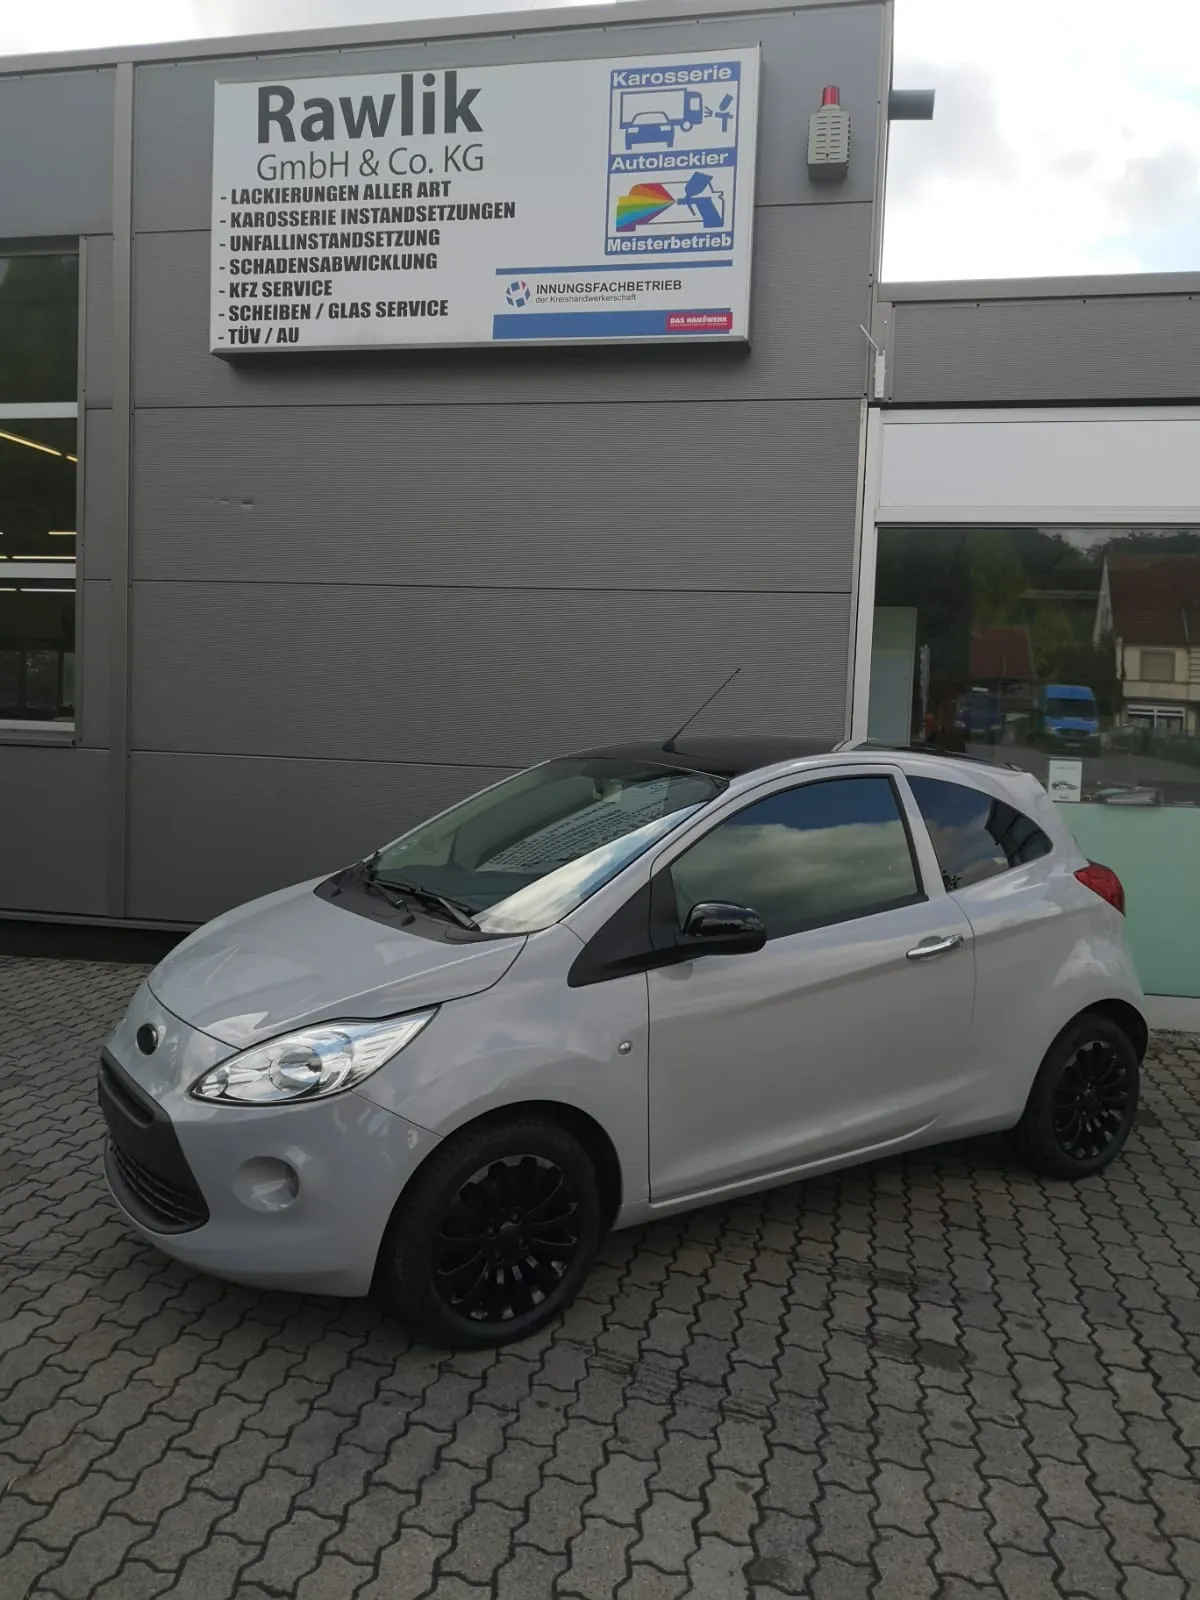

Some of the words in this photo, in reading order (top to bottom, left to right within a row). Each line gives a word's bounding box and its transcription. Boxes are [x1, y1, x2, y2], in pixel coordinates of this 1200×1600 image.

[612, 65, 732, 87] Karosserie
[257, 70, 484, 144] Rawlik
[257, 150, 350, 181] GmbH
[359, 148, 380, 177] &
[388, 147, 433, 175] Co.
[444, 144, 484, 172] KG
[611, 151, 728, 170] Autolackier
[231, 184, 359, 205] LACKIERUNGEN
[363, 182, 412, 200] ALLER
[417, 180, 451, 198] ART
[230, 209, 336, 228] KAROSSERIE
[341, 202, 516, 225] INSTANDSETZUNGEN
[230, 229, 440, 252] UNFALLINSTANDSETZUNG
[607, 233, 732, 252] Meisterbetrieb
[229, 253, 438, 275] SCHADENSABWICKLUNG
[229, 282, 258, 298] KFZ
[261, 280, 333, 297] SERVICE
[536, 280, 682, 295] INNUNGSFACHBETRIEB
[535, 296, 548, 304] der
[550, 294, 637, 304] Kreishandwerkerschaft
[229, 304, 311, 321] SCHEIBEN
[328, 302, 371, 319] GLAS
[375, 300, 448, 318] SERVICE
[228, 326, 261, 345] TÜV
[276, 327, 299, 343] AU
